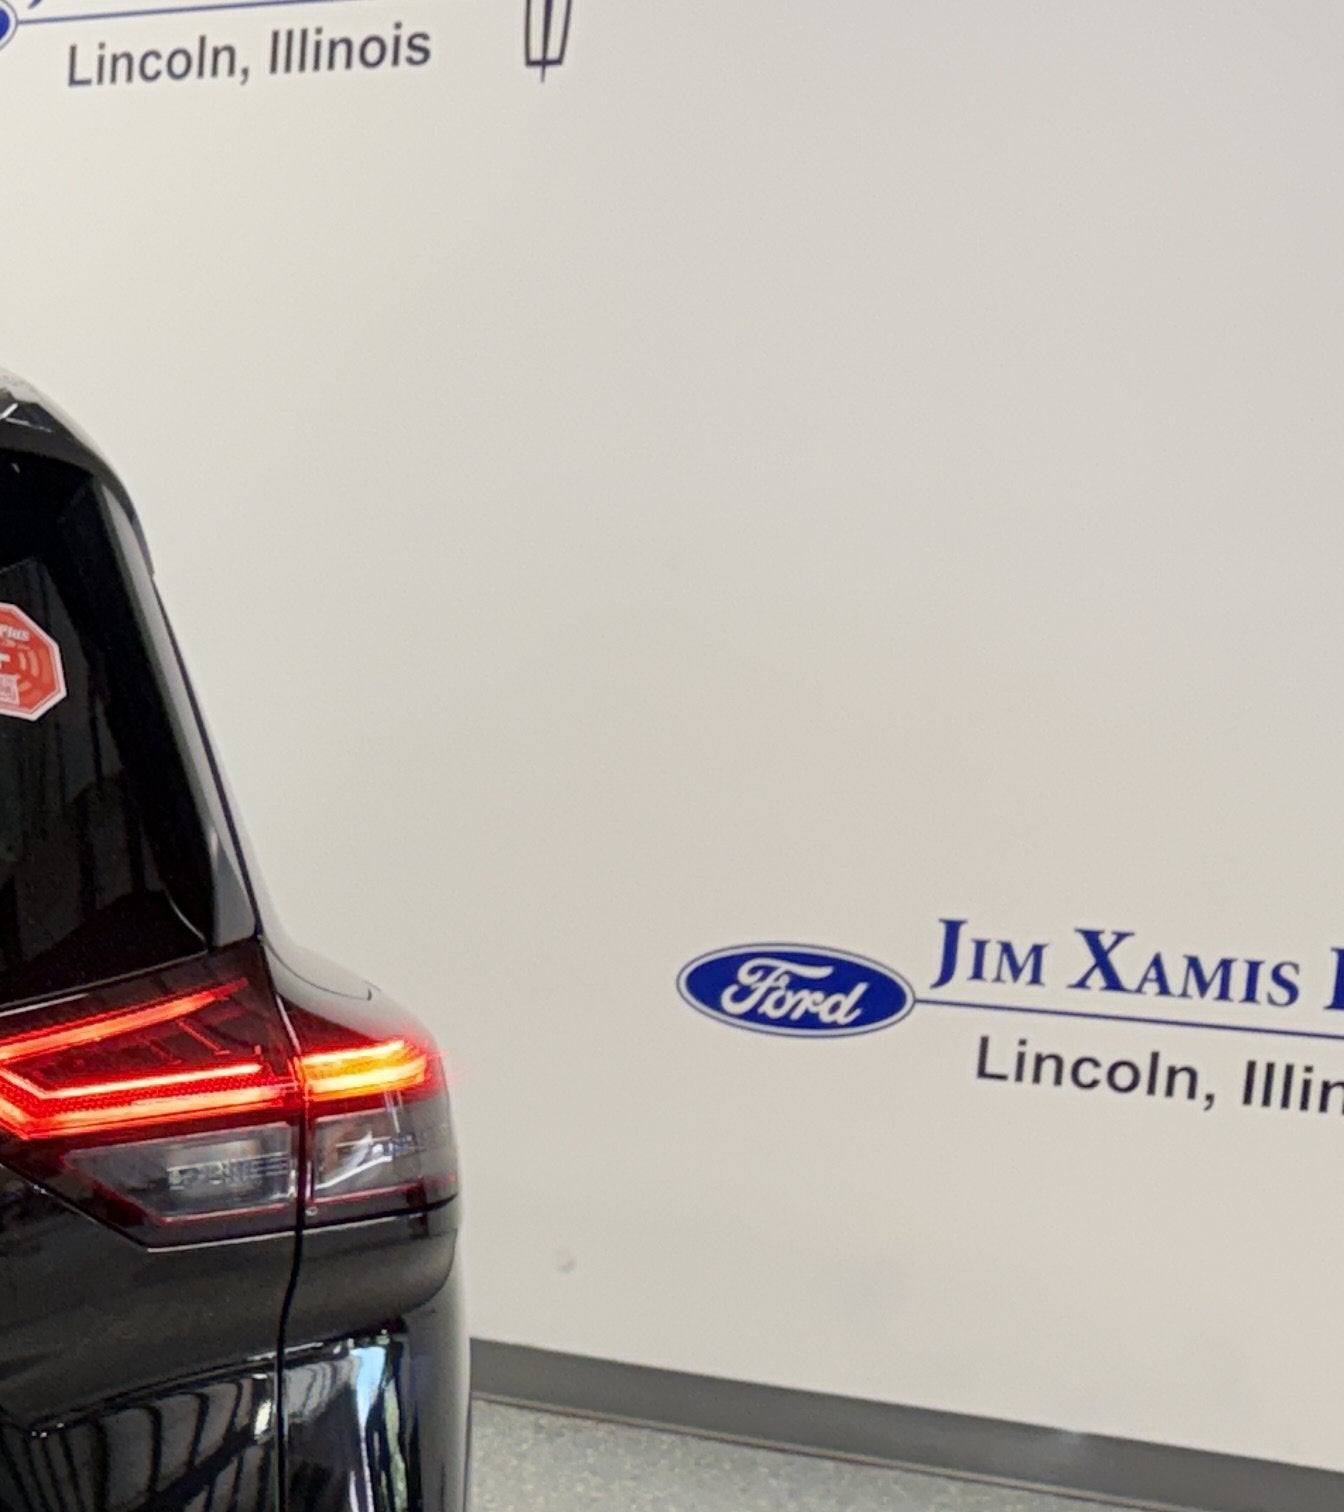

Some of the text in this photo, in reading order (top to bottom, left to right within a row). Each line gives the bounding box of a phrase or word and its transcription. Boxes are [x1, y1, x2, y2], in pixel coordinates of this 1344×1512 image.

[66, 23, 433, 87] Lincoln, Illinois
[720, 957, 863, 1025] Ford
[930, 918, 1049, 990] JIM
[1067, 928, 1301, 1008] XAMIS
[975, 1036, 1215, 1111] Lincoln,
